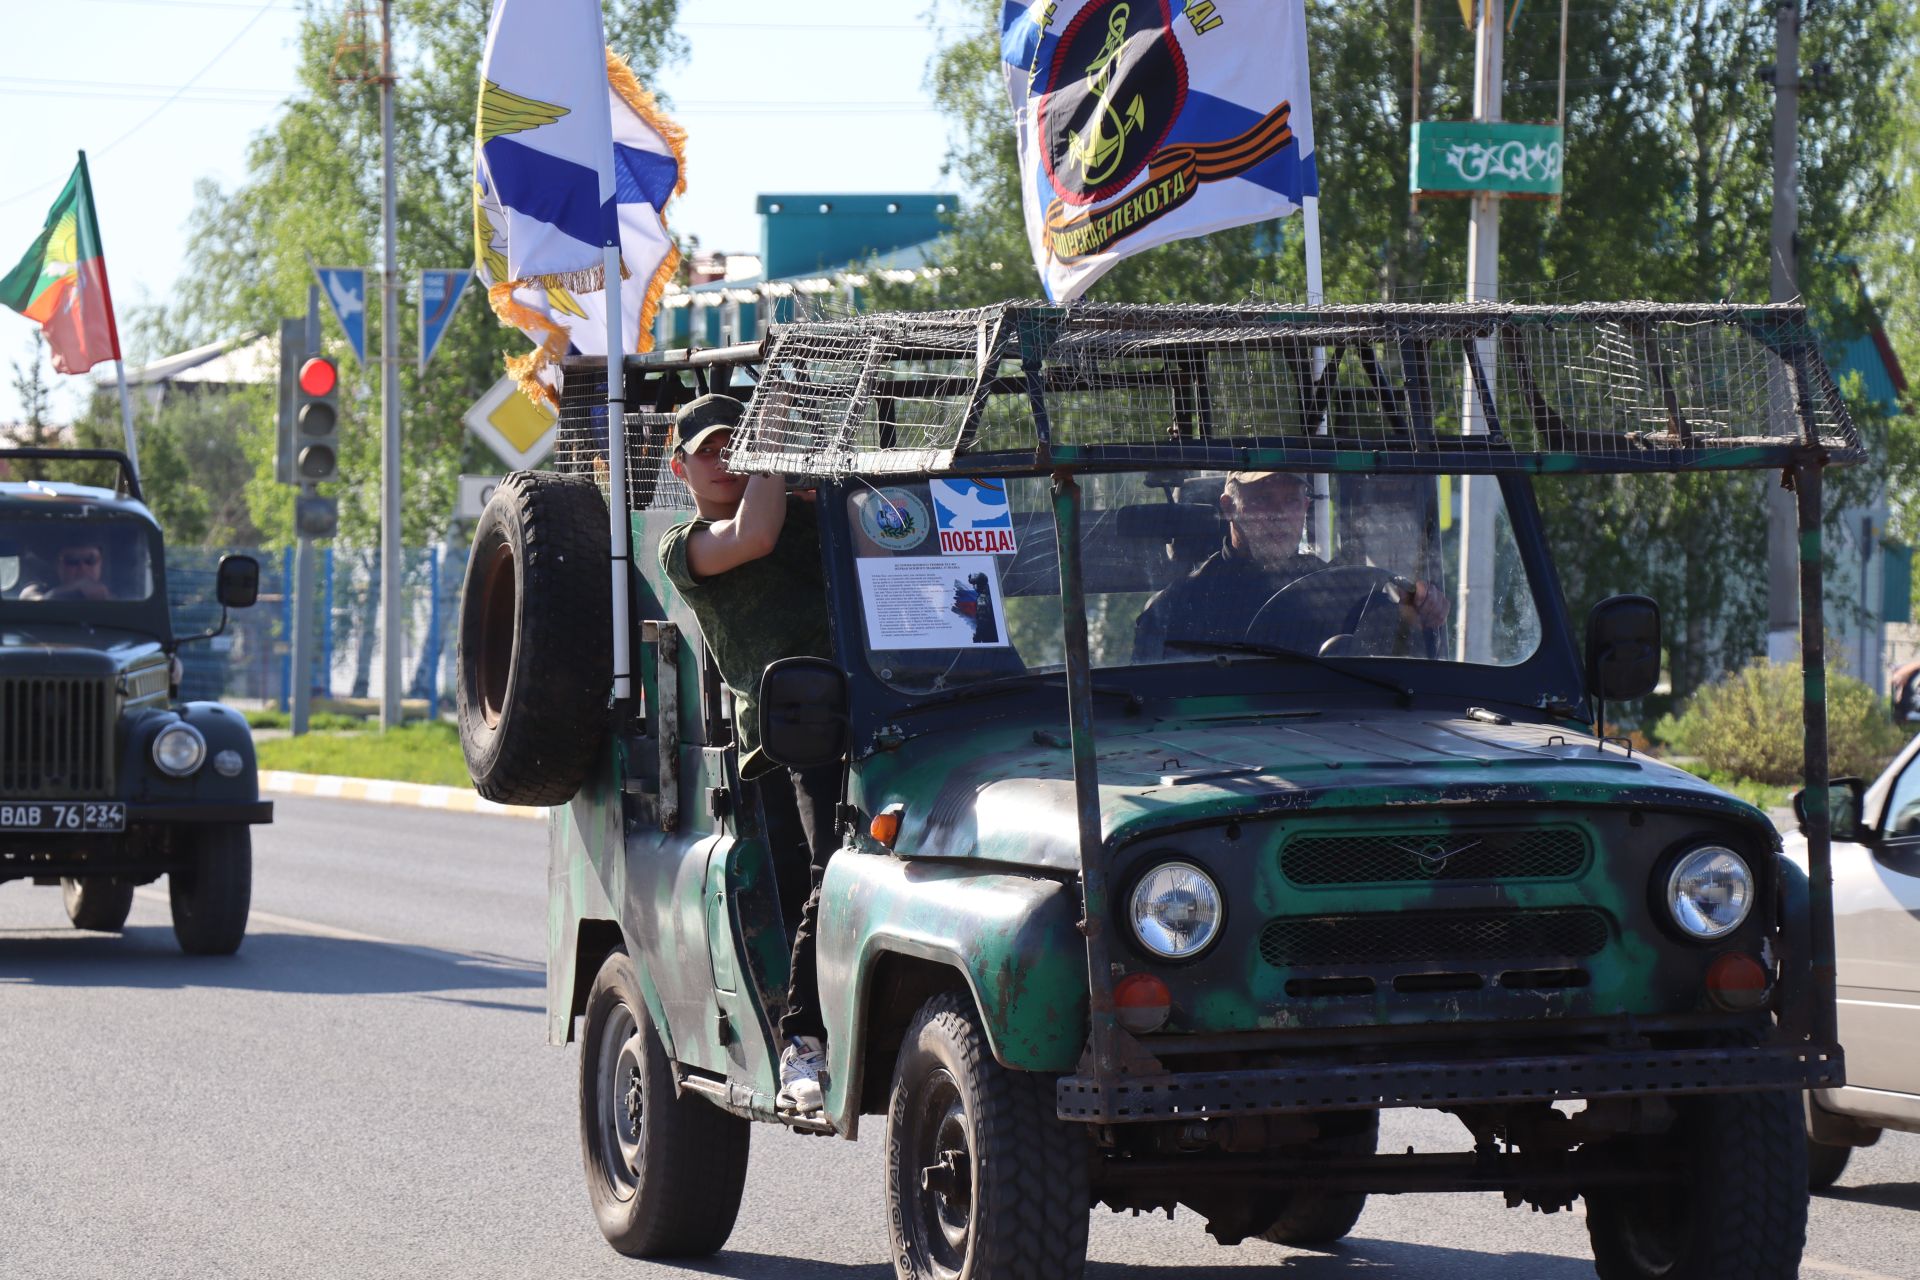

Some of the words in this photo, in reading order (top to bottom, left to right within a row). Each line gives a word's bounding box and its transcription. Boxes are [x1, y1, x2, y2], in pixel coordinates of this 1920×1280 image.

[1051, 216, 1109, 258] МОРСКАЯ
[1111, 171, 1187, 234] ПЕХОТА
[940, 530, 1015, 552] ПОБЕДА!
[0, 806, 42, 826] ВДВ
[52, 806, 81, 828] 76
[86, 804, 122, 822] 234
